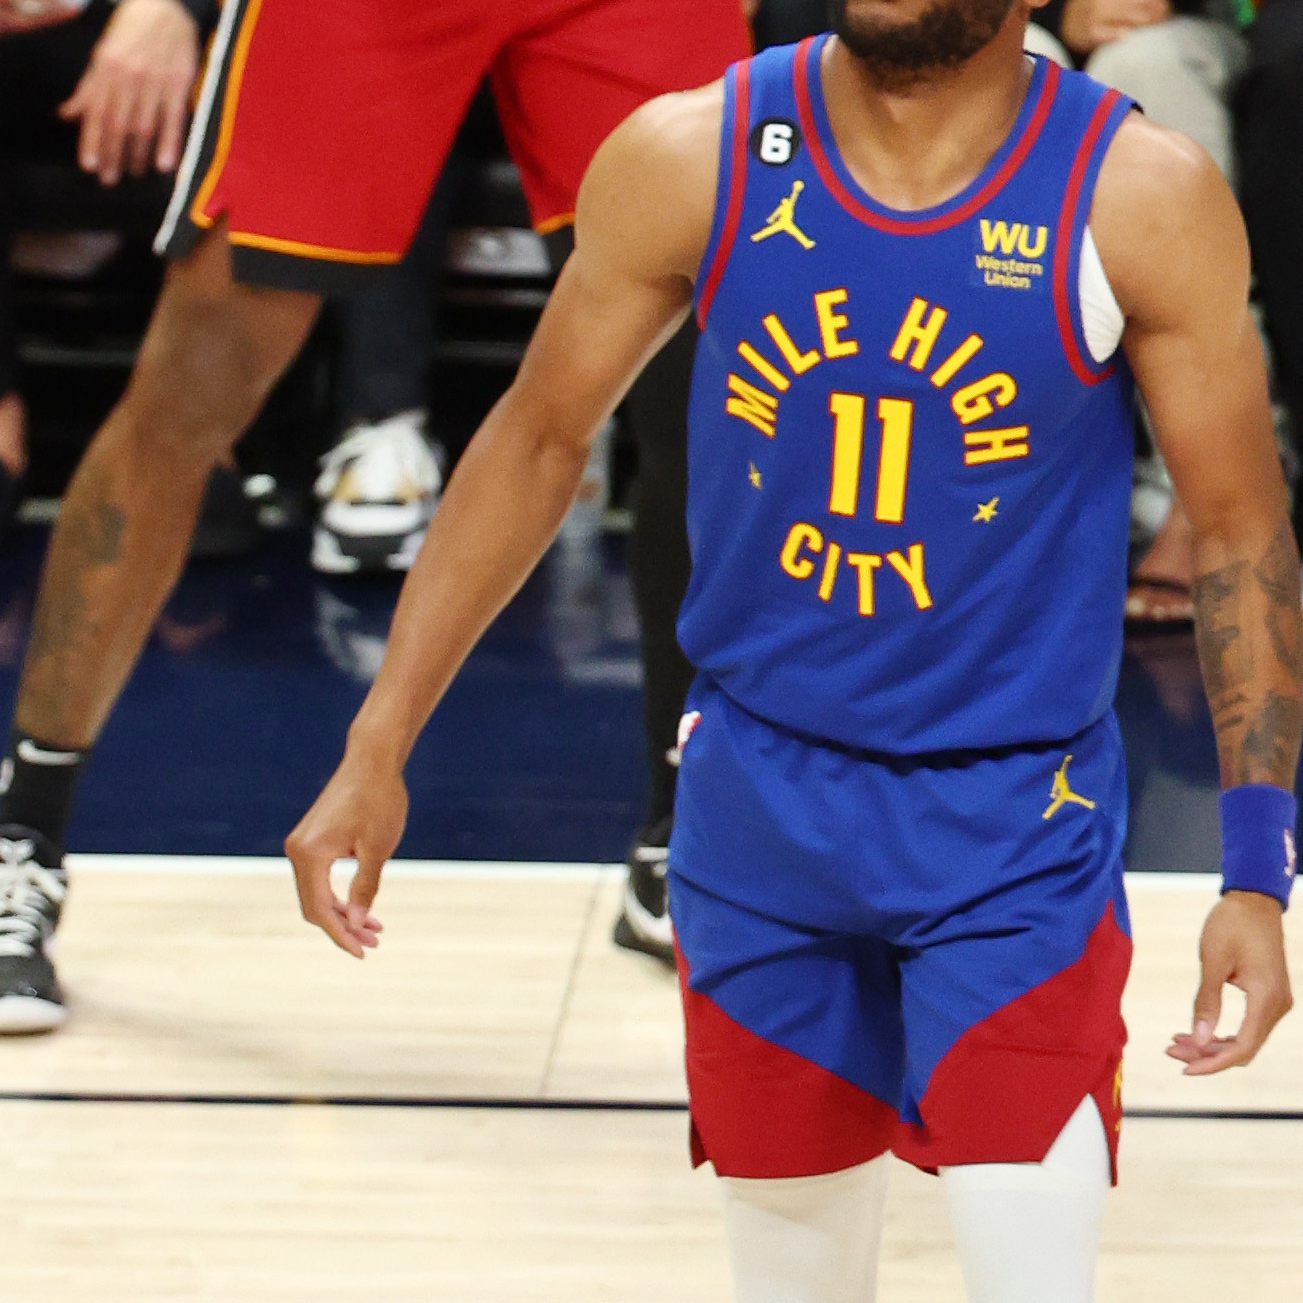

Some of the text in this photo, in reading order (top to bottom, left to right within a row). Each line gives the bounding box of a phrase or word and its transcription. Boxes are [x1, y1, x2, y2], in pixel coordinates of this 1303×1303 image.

[760, 123, 793, 164] 6
[978, 218, 1048, 259] WU
[975, 253, 1044, 277] Western
[983, 268, 1032, 290] Union
[726, 287, 1030, 466] MILE HIGH
[828, 390, 913, 524] 11
[779, 520, 934, 617] CITY
